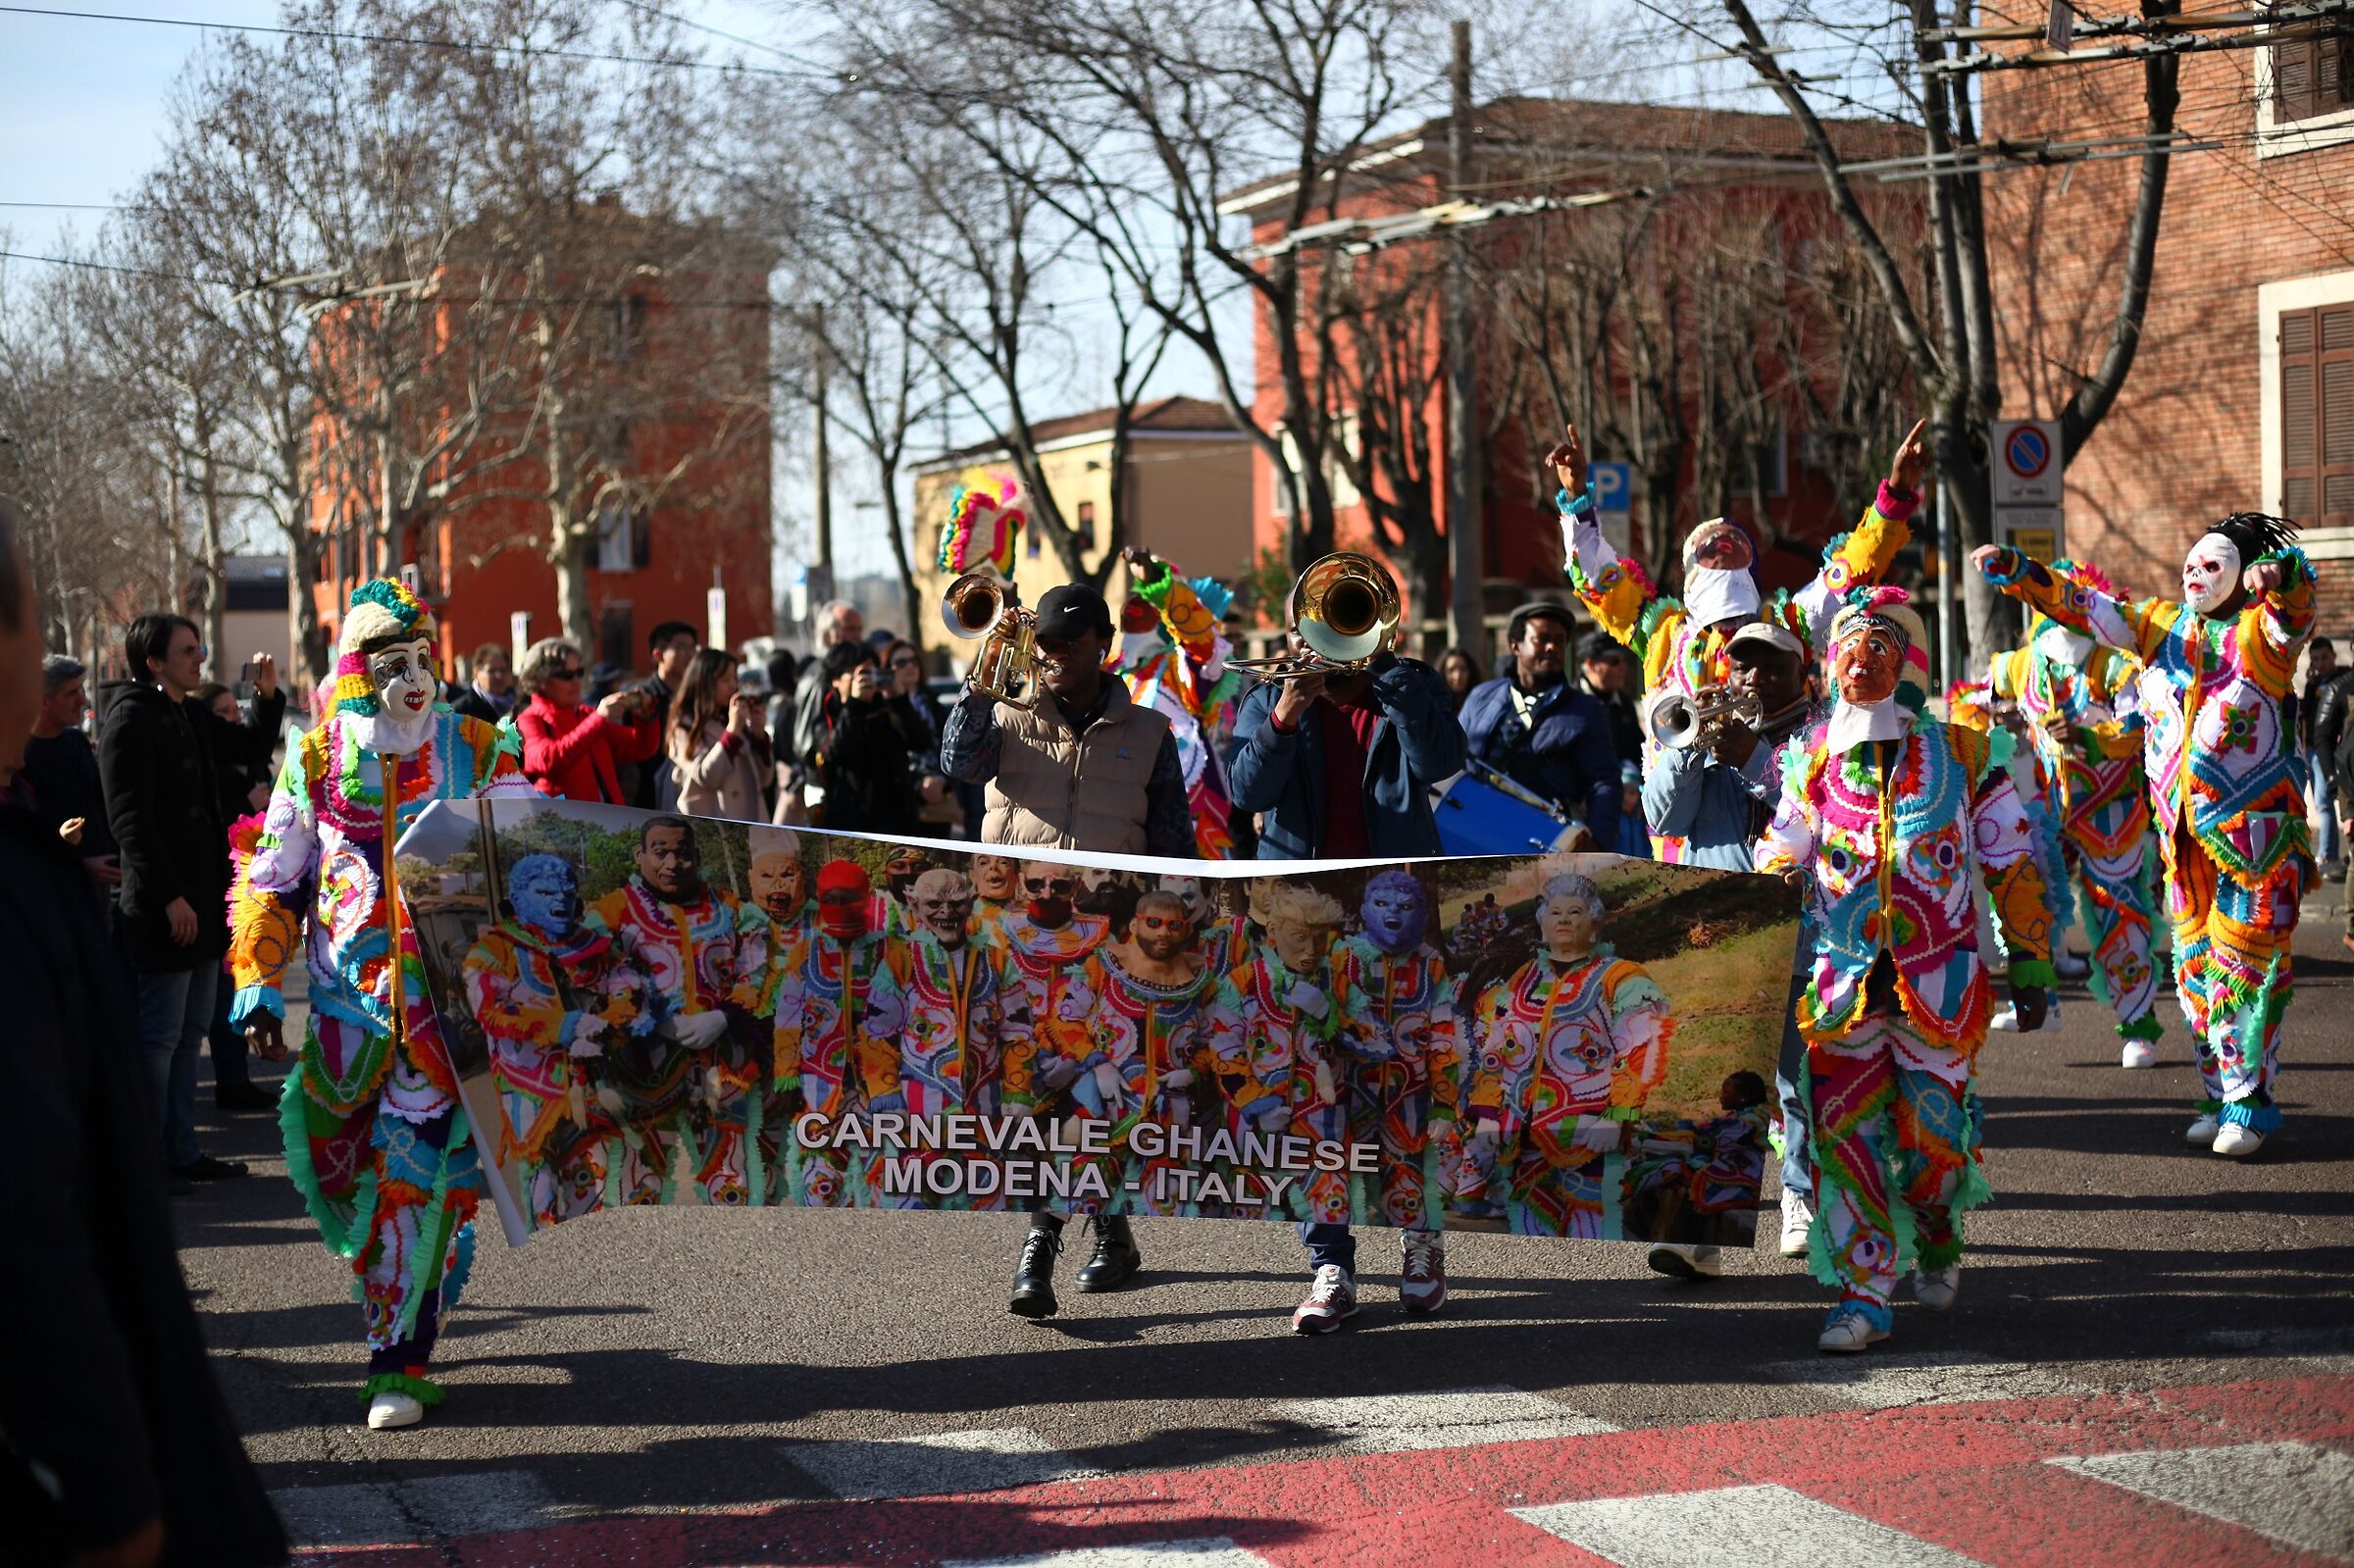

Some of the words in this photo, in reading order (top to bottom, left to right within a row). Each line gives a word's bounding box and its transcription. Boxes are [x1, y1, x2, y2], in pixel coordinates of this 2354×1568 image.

[1594, 468, 1621, 505] P
[795, 1112, 1111, 1154] CARNEVALE
[1128, 1122, 1380, 1173] GHANESE
[885, 1158, 1109, 1199] MODENA
[1124, 1181, 1140, 1190] -
[1156, 1167, 1295, 1206] ITALY
